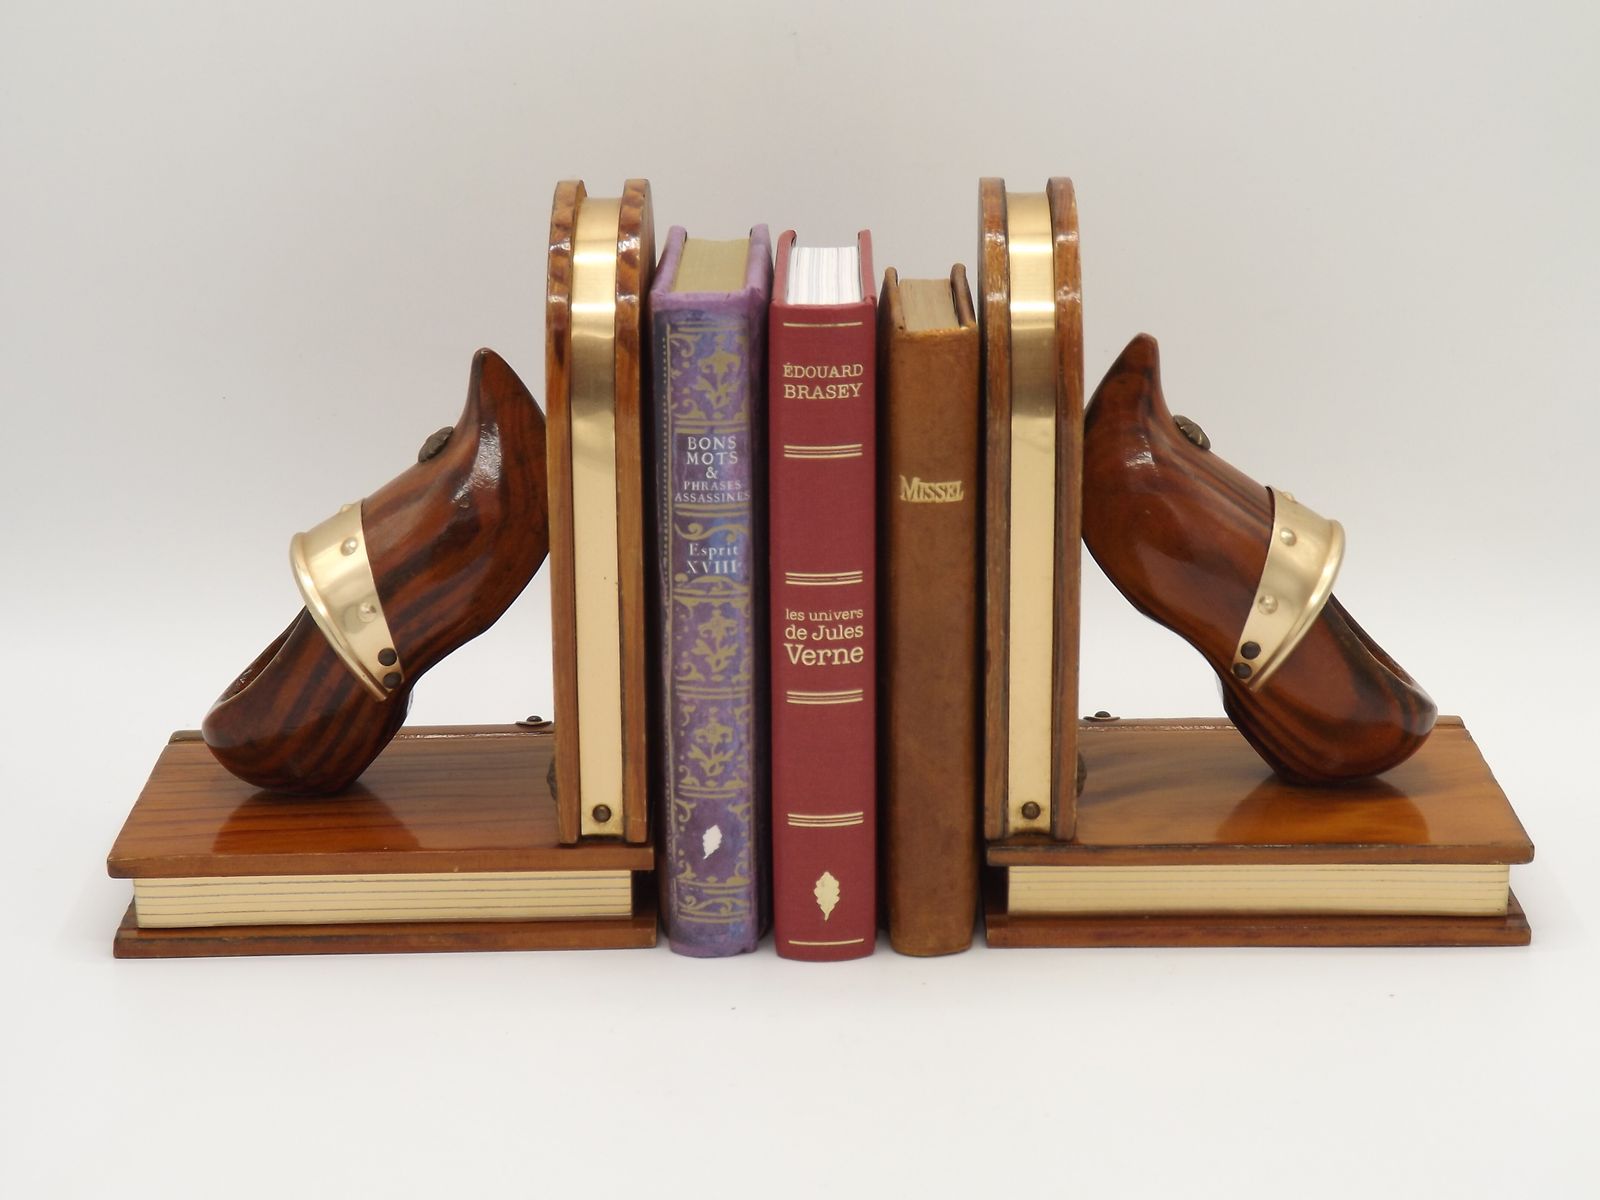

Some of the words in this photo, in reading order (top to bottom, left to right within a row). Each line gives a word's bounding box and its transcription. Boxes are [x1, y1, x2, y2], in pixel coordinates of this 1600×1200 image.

[783, 363, 864, 379] ÉDOUARD
[783, 383, 864, 400] BRASEY
[687, 436, 737, 450] BONS
[686, 451, 739, 465] MOTS
[705, 466, 718, 479] &
[683, 480, 742, 491] PHRASES
[674, 492, 751, 502] ASSASSINES
[689, 543, 739, 560] Esprit
[687, 560, 738, 574] XVIII
[785, 608, 805, 621] les
[808, 608, 864, 622] univers
[785, 624, 808, 641] de
[811, 624, 864, 641] Jules
[783, 642, 864, 666] Verne
